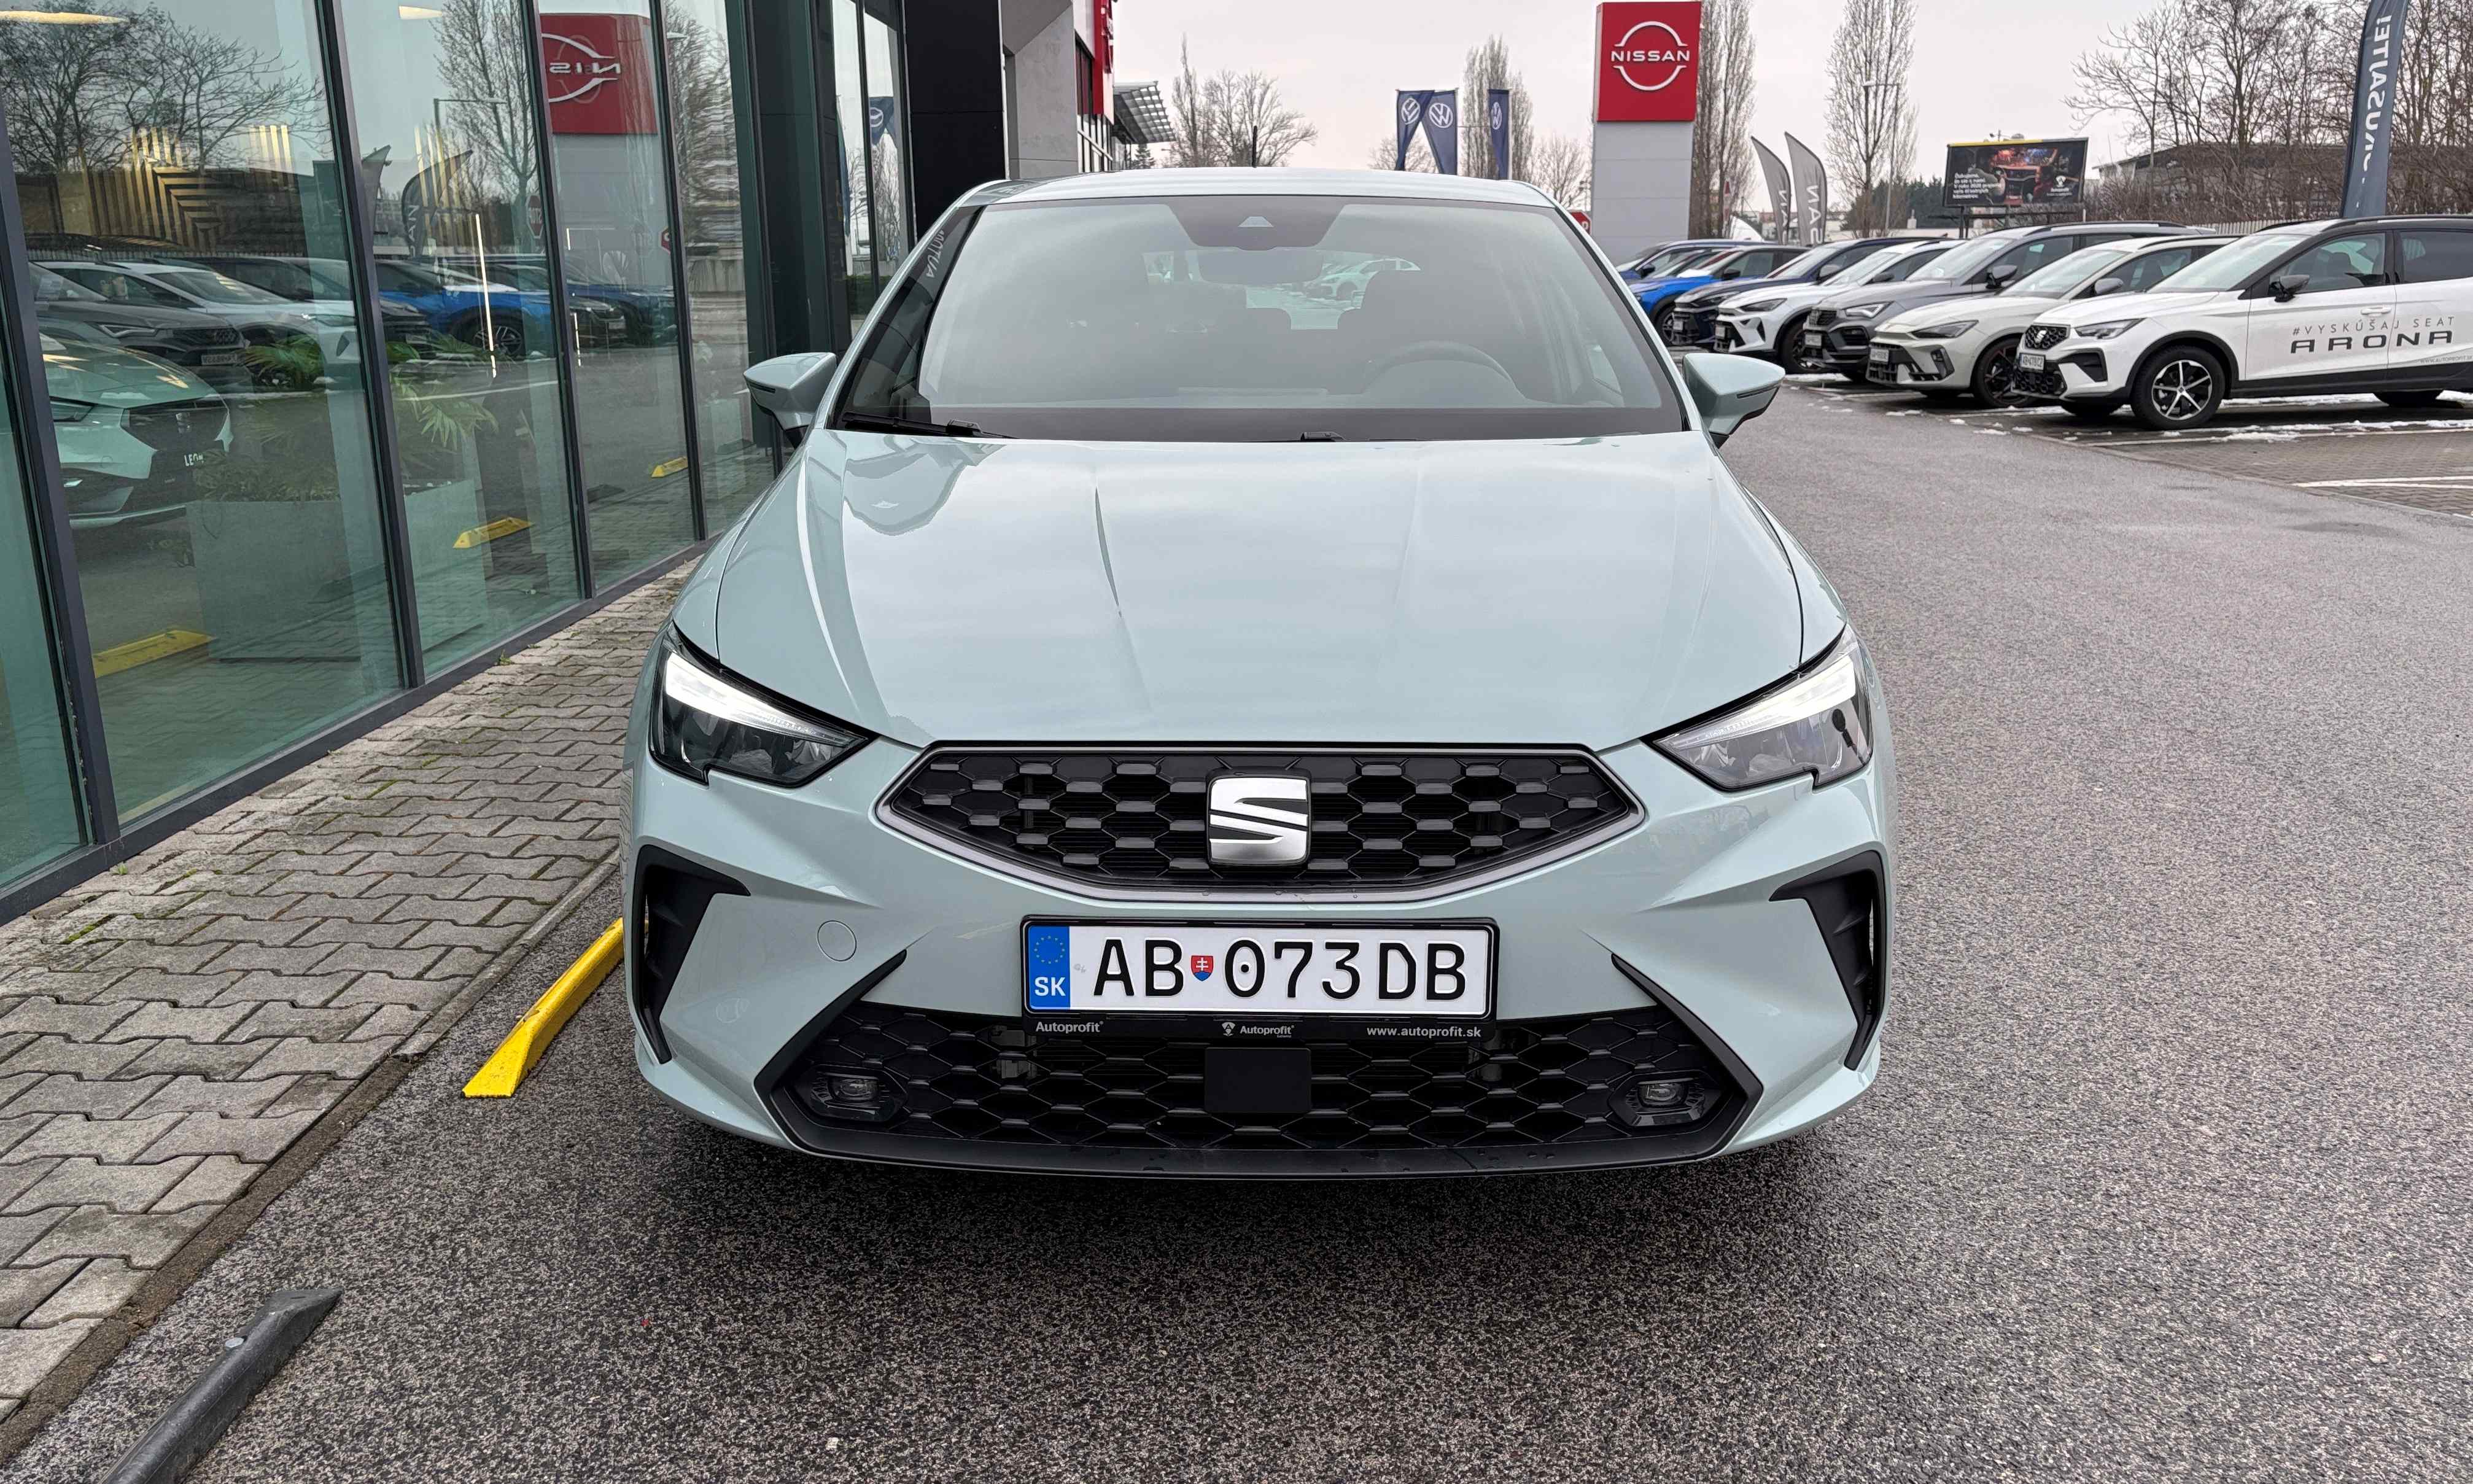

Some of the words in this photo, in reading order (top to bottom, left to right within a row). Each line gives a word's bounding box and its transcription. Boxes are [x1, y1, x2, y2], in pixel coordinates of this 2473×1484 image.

[1610, 50, 1690, 62] NISSAN
[2292, 319, 2399, 336] #VYSKÚŠAJ
[2413, 316, 2455, 328] SEAT
[2291, 330, 2453, 354] ARONA
[1093, 939, 1184, 997] AB
[1224, 939, 1466, 1000] 073DB
[1035, 977, 1066, 996] SK
[1367, 1026, 1481, 1039] www.autoprofit.sk
